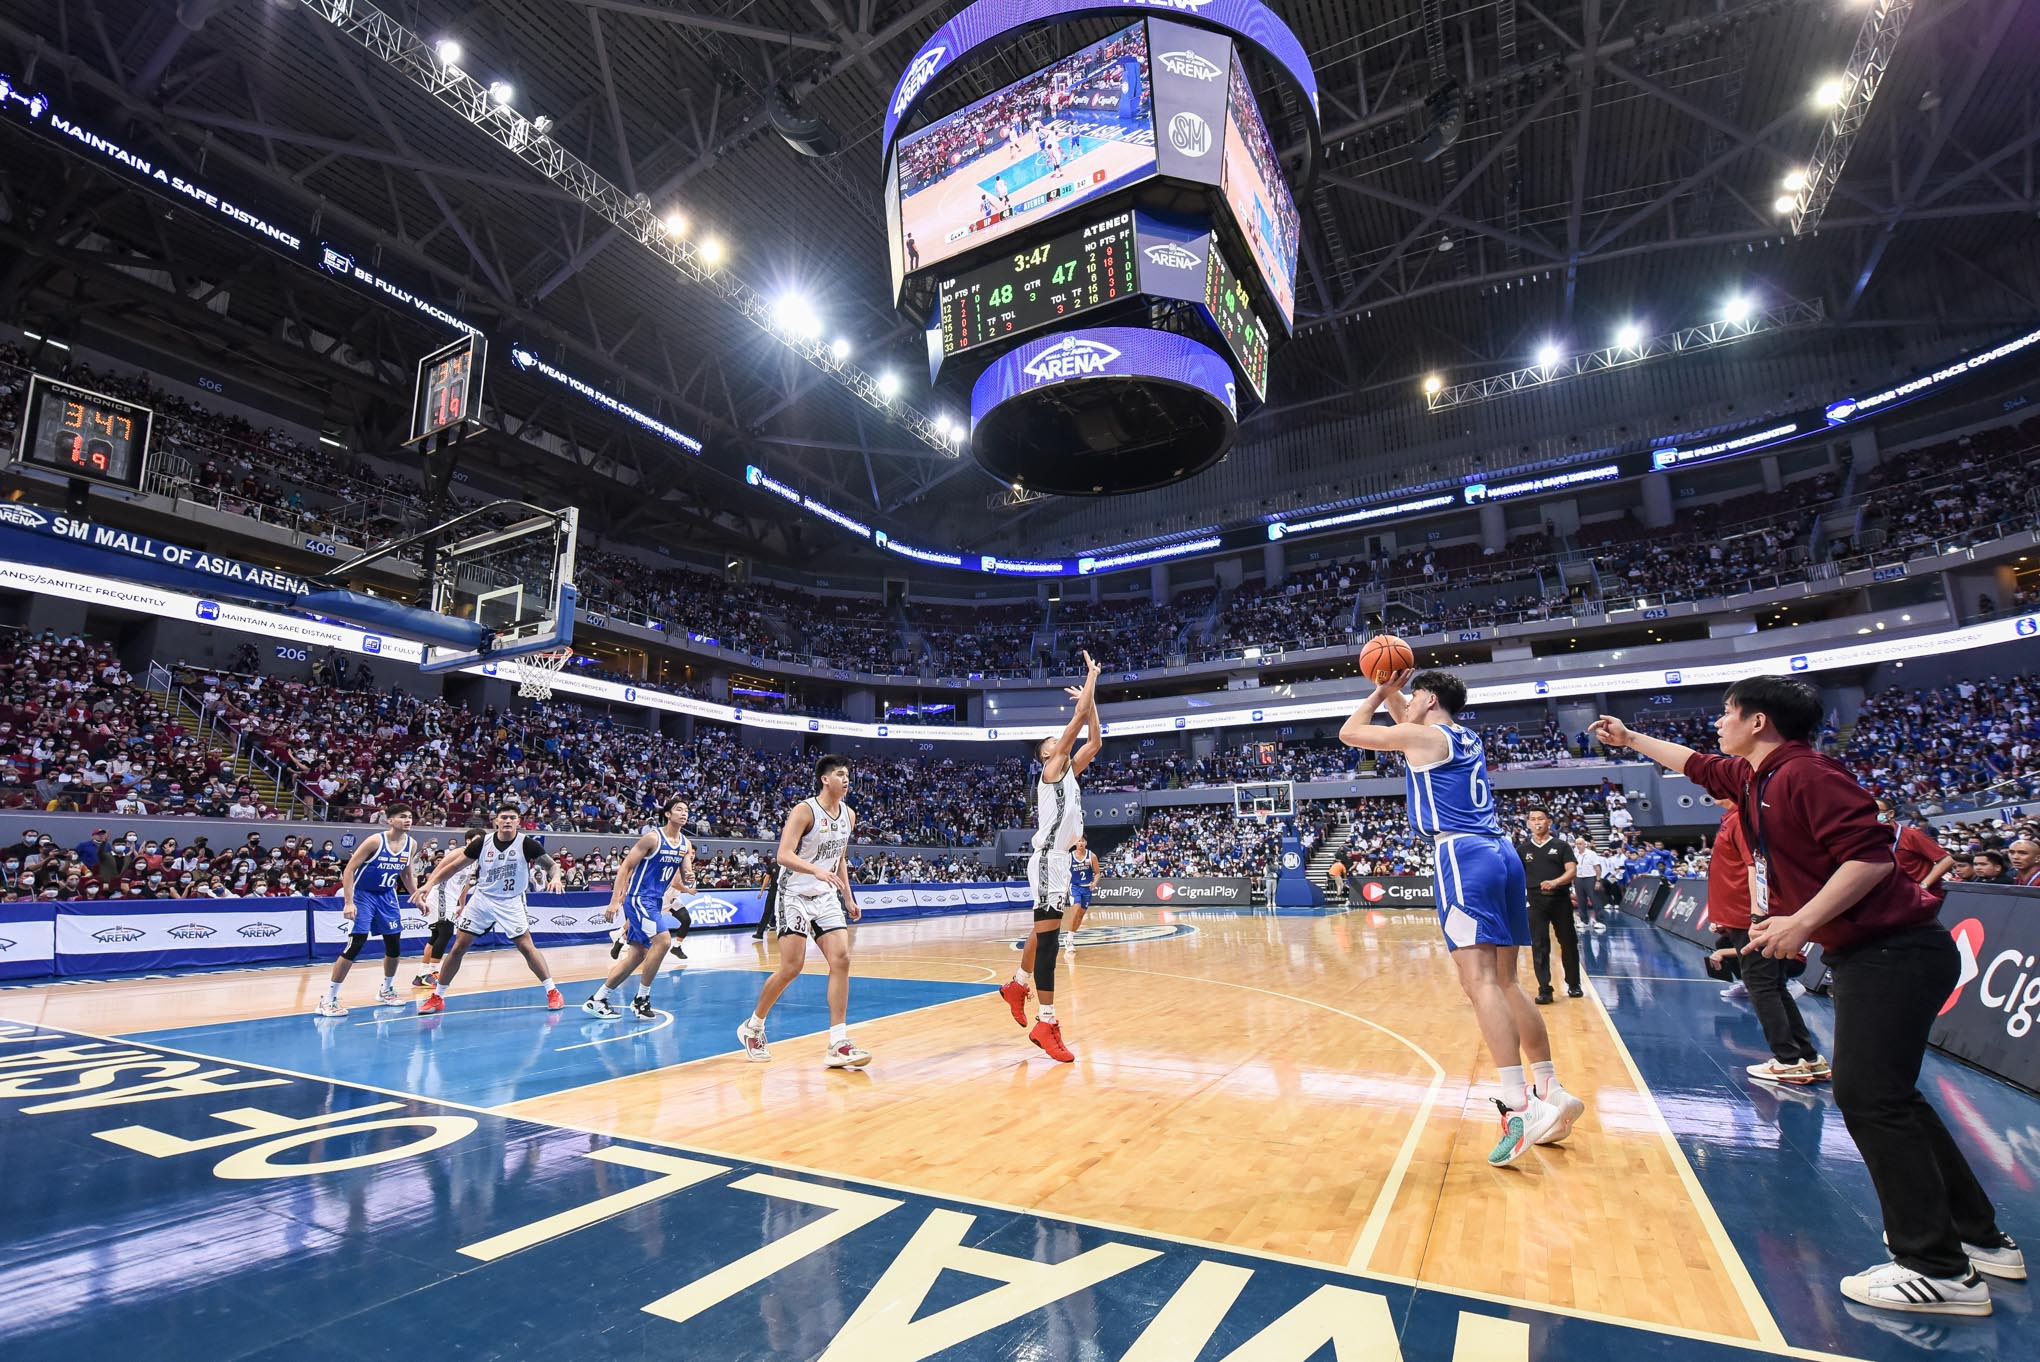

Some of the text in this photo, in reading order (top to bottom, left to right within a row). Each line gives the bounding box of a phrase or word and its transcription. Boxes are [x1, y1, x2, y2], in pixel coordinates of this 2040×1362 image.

[1167, 60, 1212, 82] ARENA
[898, 61, 934, 118] ARENA
[1173, 116, 1205, 152] SM
[52, 115, 300, 250] MAINTAIN A SAFE DISTANCE
[984, 218, 992, 227] UP
[1024, 196, 1045, 210] ATENEO
[1083, 214, 1129, 238] ATENEO
[1085, 229, 1130, 252] NO PTS PF
[1014, 244, 1051, 272] 3:47
[1090, 253, 1096, 262] 2
[1107, 247, 1113, 256] 9
[1152, 253, 1192, 270] ARENA
[1052, 260, 1077, 284] 47
[1087, 264, 1096, 273] 10
[1104, 258, 1113, 267] 18
[1091, 262, 1131, 282] 6 0 0
[355, 268, 373, 284] BE
[376, 278, 413, 303] FULLY
[944, 279, 956, 290] UP
[1024, 280, 1041, 291] QTR
[1088, 272, 1132, 294] 15 3 0
[942, 284, 980, 304] NO PTS PF
[989, 284, 1013, 307] 48
[1030, 293, 1036, 301] 3
[1051, 288, 1082, 304] TOL TF
[1089, 283, 1133, 305] 16 0 2
[944, 305, 952, 314] 12
[1057, 300, 1081, 314] 3 2
[944, 314, 952, 324] 32
[987, 311, 1016, 326] TF TOL
[945, 324, 953, 333] 15
[989, 322, 1012, 337] 2 3
[945, 334, 953, 343] 22
[945, 343, 954, 352] 33
[960, 338, 968, 347] 10
[1035, 354, 1105, 383] ARENA
[199, 378, 223, 393] 506
[1856, 390, 1896, 410] WEAR
[1896, 376, 1933, 396] YOUR
[1932, 362, 1968, 383] FACE
[51, 385, 131, 413] DAKTRONICS
[538, 362, 703, 451] WEAR YOUR FACE COVERINGS PROPERLY
[452, 471, 469, 483] 507
[306, 540, 335, 556] 406
[52, 517, 310, 596] SM MALL OF ASIA ARENA
[96, 588, 167, 607] FREQUENTLY
[587, 615, 605, 626] 407
[1646, 610, 1666, 618] 413
[222, 613, 268, 628] MAINTAIN
[278, 623, 300, 634] SAFE
[302, 628, 342, 642] DISTANCE
[1462, 632, 1480, 641] 412
[278, 646, 307, 662] 206
[394, 646, 415, 656] FULLY
[1460, 712, 1476, 720] 212
[920, 743, 933, 751] 209
[1471, 761, 1488, 808] 6
[378, 863, 405, 871] ATENEO
[660, 866, 673, 882] 10
[379, 873, 398, 887] 16
[1080, 872, 1086, 880] 2
[503, 879, 515, 891] 32
[1178, 886, 1238, 899] CignalPlay
[460, 918, 471, 929] 32
[689, 909, 732, 924] ARENA
[795, 916, 807, 932] 33
[390, 921, 398, 930] 16
[99, 934, 138, 943] ARENA
[174, 931, 209, 939] ARENA
[243, 929, 276, 938] ARENA
[92, 1101, 478, 1179] OF
